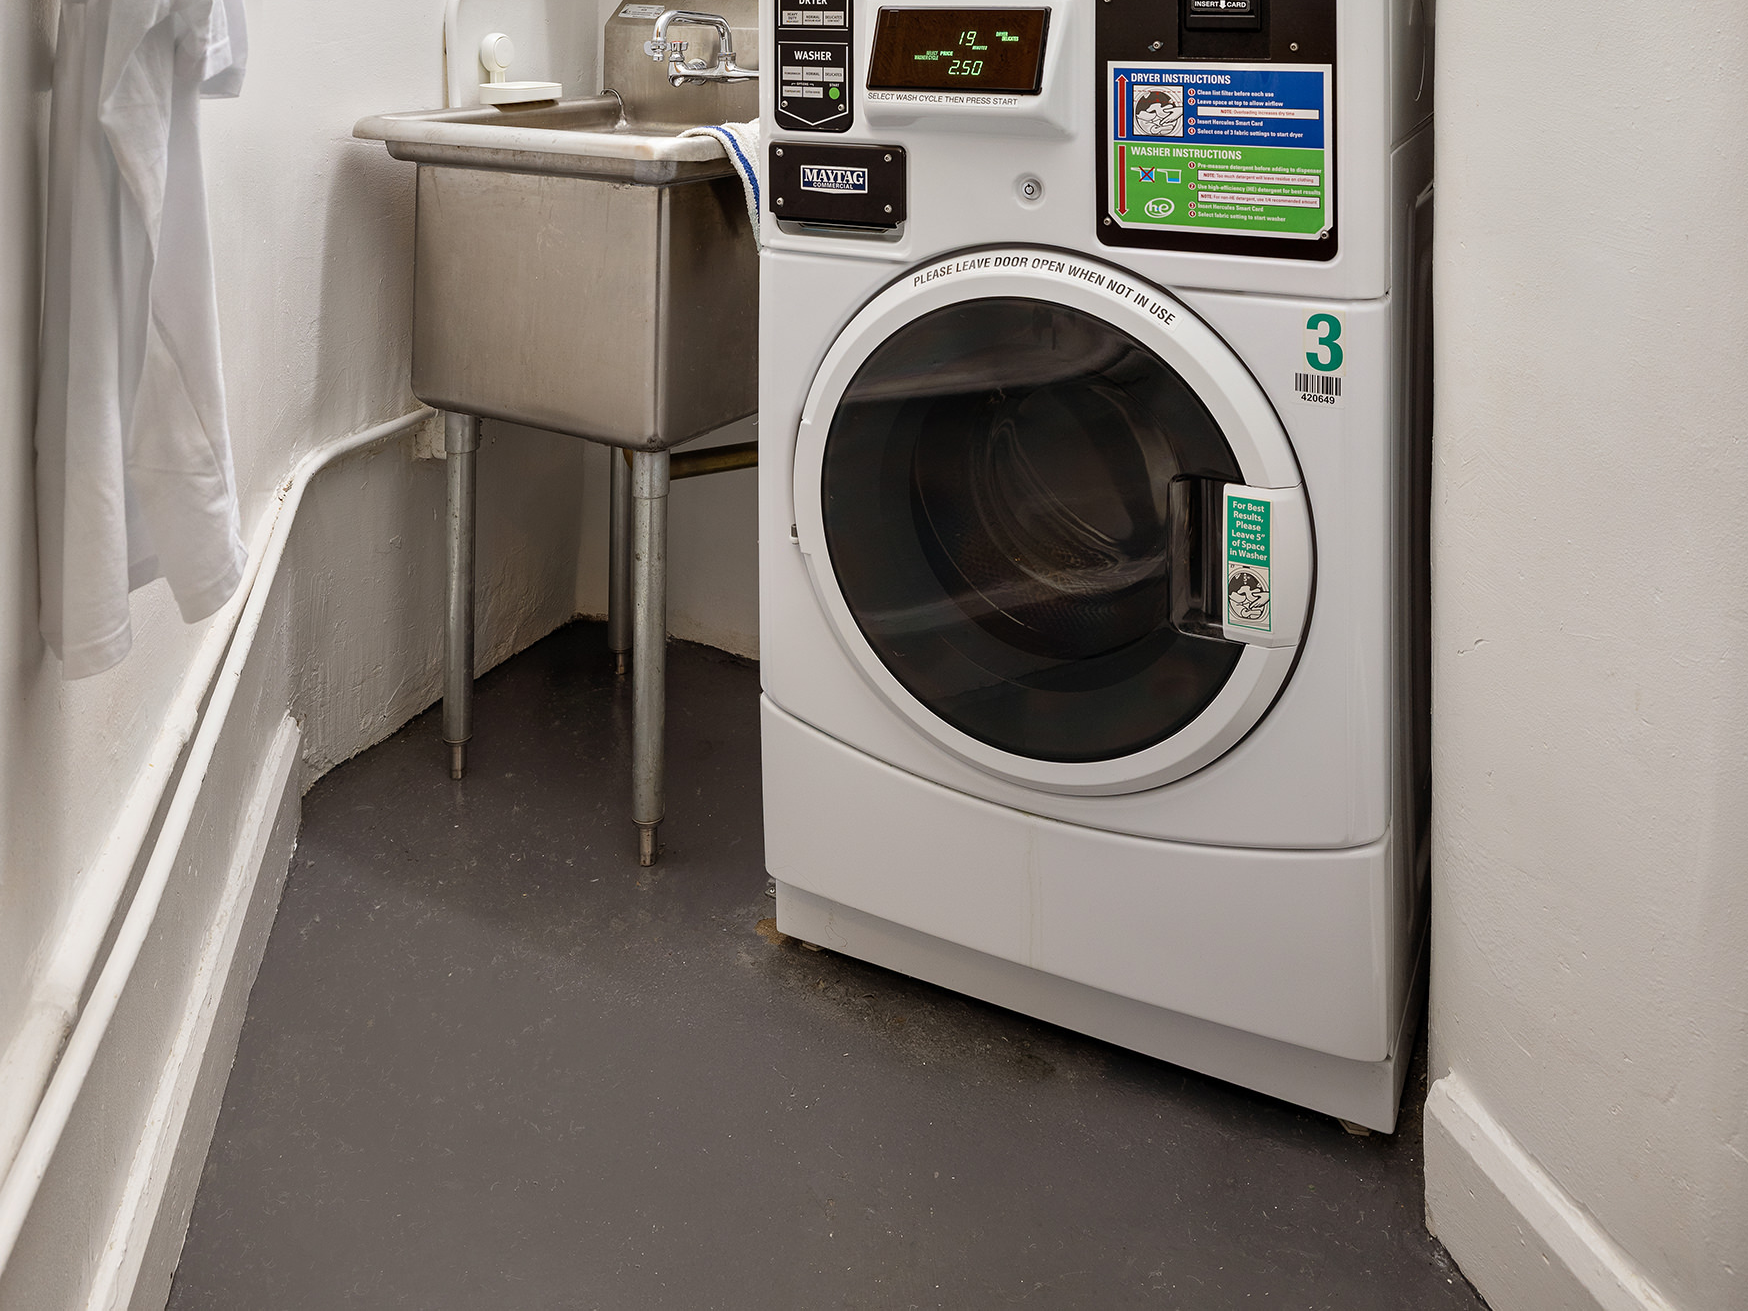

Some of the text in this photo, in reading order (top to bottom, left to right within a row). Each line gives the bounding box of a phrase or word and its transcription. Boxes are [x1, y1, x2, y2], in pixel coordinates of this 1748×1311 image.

[1194, 0, 1247, 9] INSERT CARD
[959, 31, 977, 46] 19
[794, 51, 832, 61] WASHER
[948, 60, 984, 76] 2.50
[1131, 73, 1231, 85] DRYER INSTRUCTIONS
[868, 92, 895, 101] SELECT
[919, 94, 943, 102] CYCLE
[945, 95, 965, 103] THEN
[966, 96, 991, 104] PRESS
[992, 97, 1018, 105] START
[1131, 147, 1242, 160] WASHER INSTRUCTIONS
[803, 168, 864, 184] MAYTAG
[812, 181, 854, 190] COMMERCIAL
[913, 256, 1176, 326] PLEASE LEAVE DOOR OPEN WHEN NOT IN USE
[1305, 313, 1344, 372] 3
[1301, 394, 1336, 406] 420649
[1233, 501, 1264, 512] For Best
[1233, 511, 1264, 523] Results,
[1236, 521, 1261, 531] Please
[1231, 529, 1255, 540] Leave
[1232, 539, 1265, 551] of Space
[1229, 548, 1268, 561] in Washer
